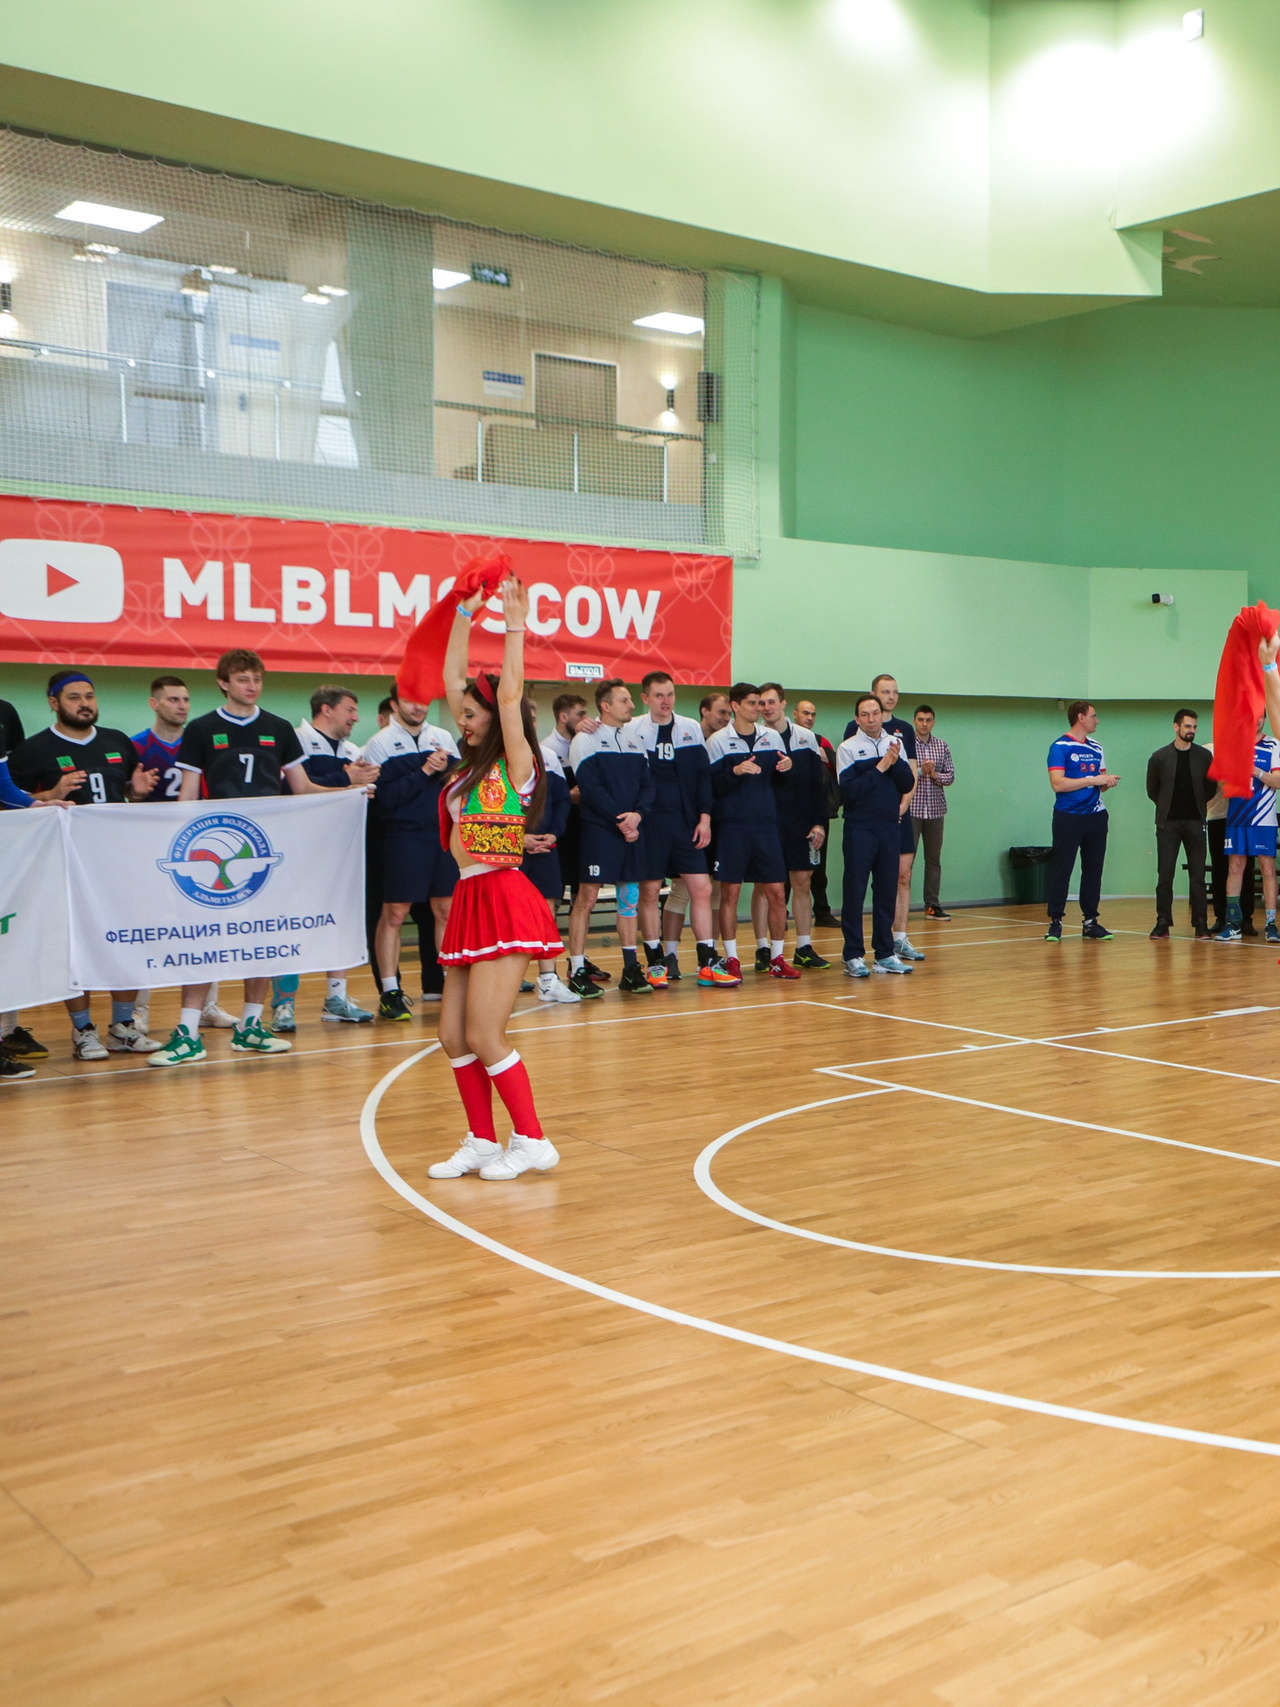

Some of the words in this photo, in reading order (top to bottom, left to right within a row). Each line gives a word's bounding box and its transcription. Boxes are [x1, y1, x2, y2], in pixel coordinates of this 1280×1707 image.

[163, 557, 661, 640] MLBLMCOW
[656, 742, 675, 761] 19
[238, 753, 255, 783] 7
[88, 772, 107, 803] 9
[588, 864, 601, 877] 19
[105, 923, 221, 945] ФЕДЕРАЦИЯ
[227, 913, 336, 937] ВОЛЕЙБОЛА
[147, 957, 157, 968] г.
[163, 943, 301, 968] АЛЬМЕТЬЕВСК
